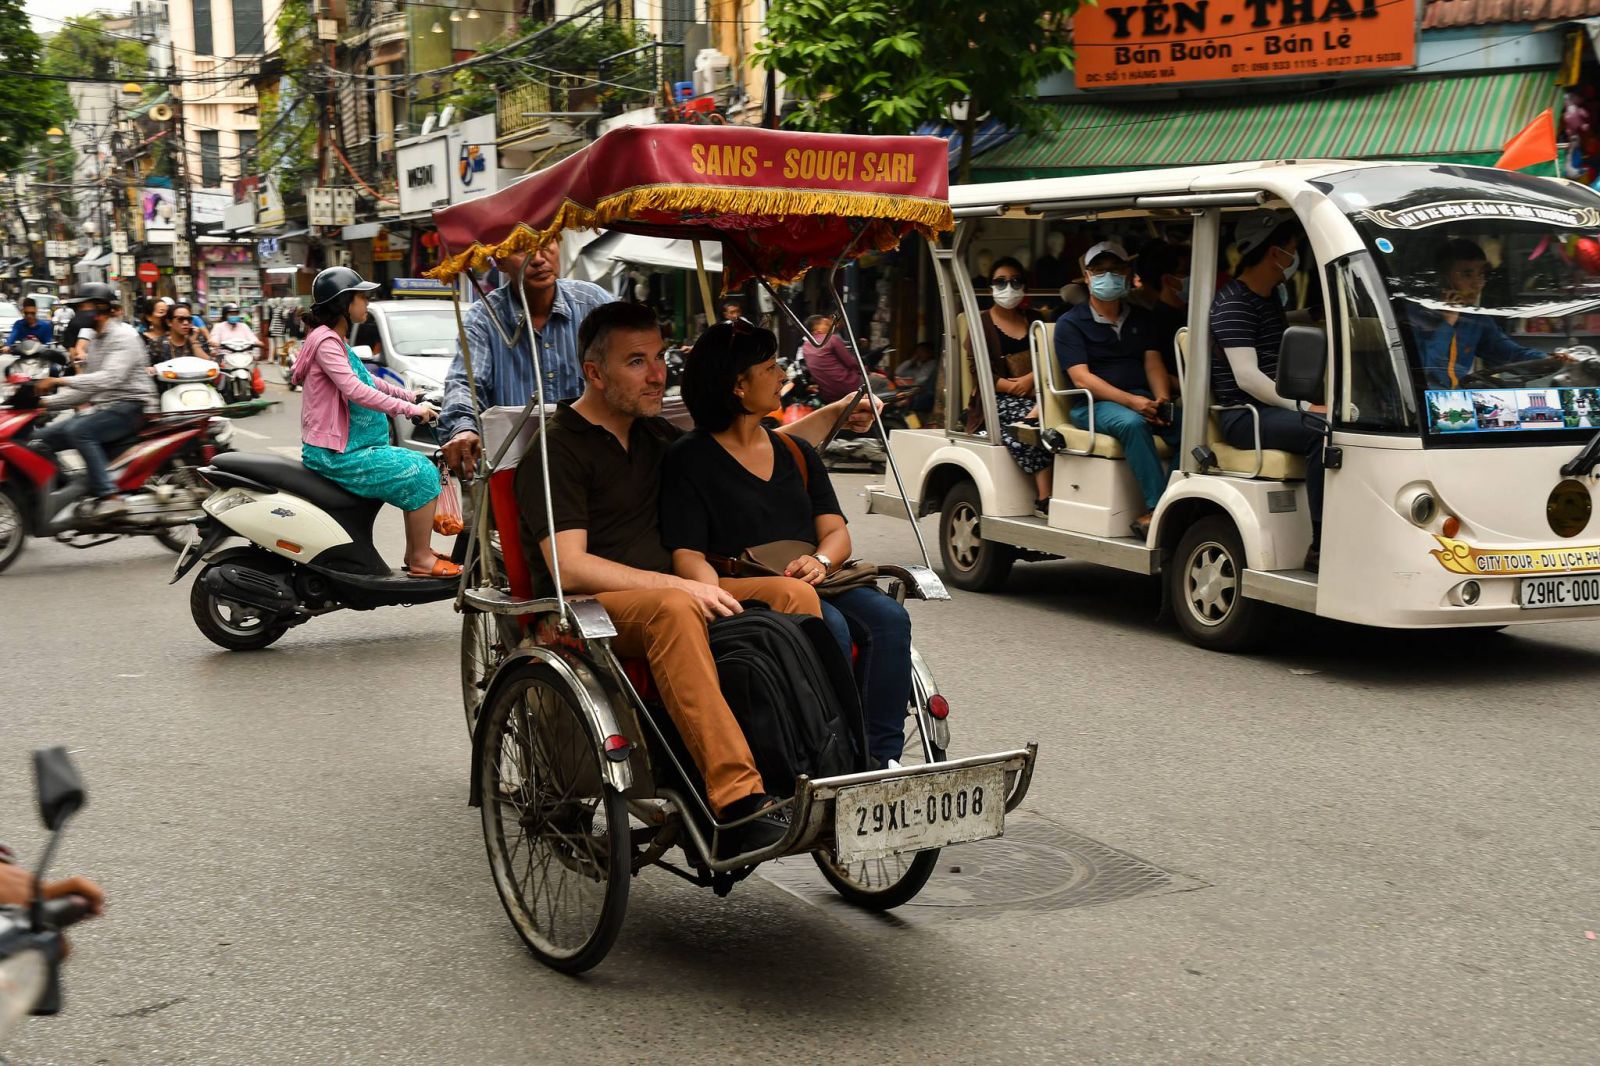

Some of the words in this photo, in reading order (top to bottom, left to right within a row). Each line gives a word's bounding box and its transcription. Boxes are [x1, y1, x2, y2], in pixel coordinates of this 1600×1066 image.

[1105, 0, 1209, 39] YÊN
[1114, 44, 1161, 65] Bán
[1170, 40, 1232, 61] Buôn
[1264, 33, 1313, 55] Bán
[1324, 28, 1352, 51] Lẻ
[691, 143, 758, 178] SANS
[783, 148, 855, 181] SOUCI
[860, 151, 917, 183] SARL
[1477, 555, 1501, 570] CITY
[1505, 554, 1533, 569] TOUR
[1540, 554, 1556, 567] DU
[855, 785, 984, 835] 29XL-0008
